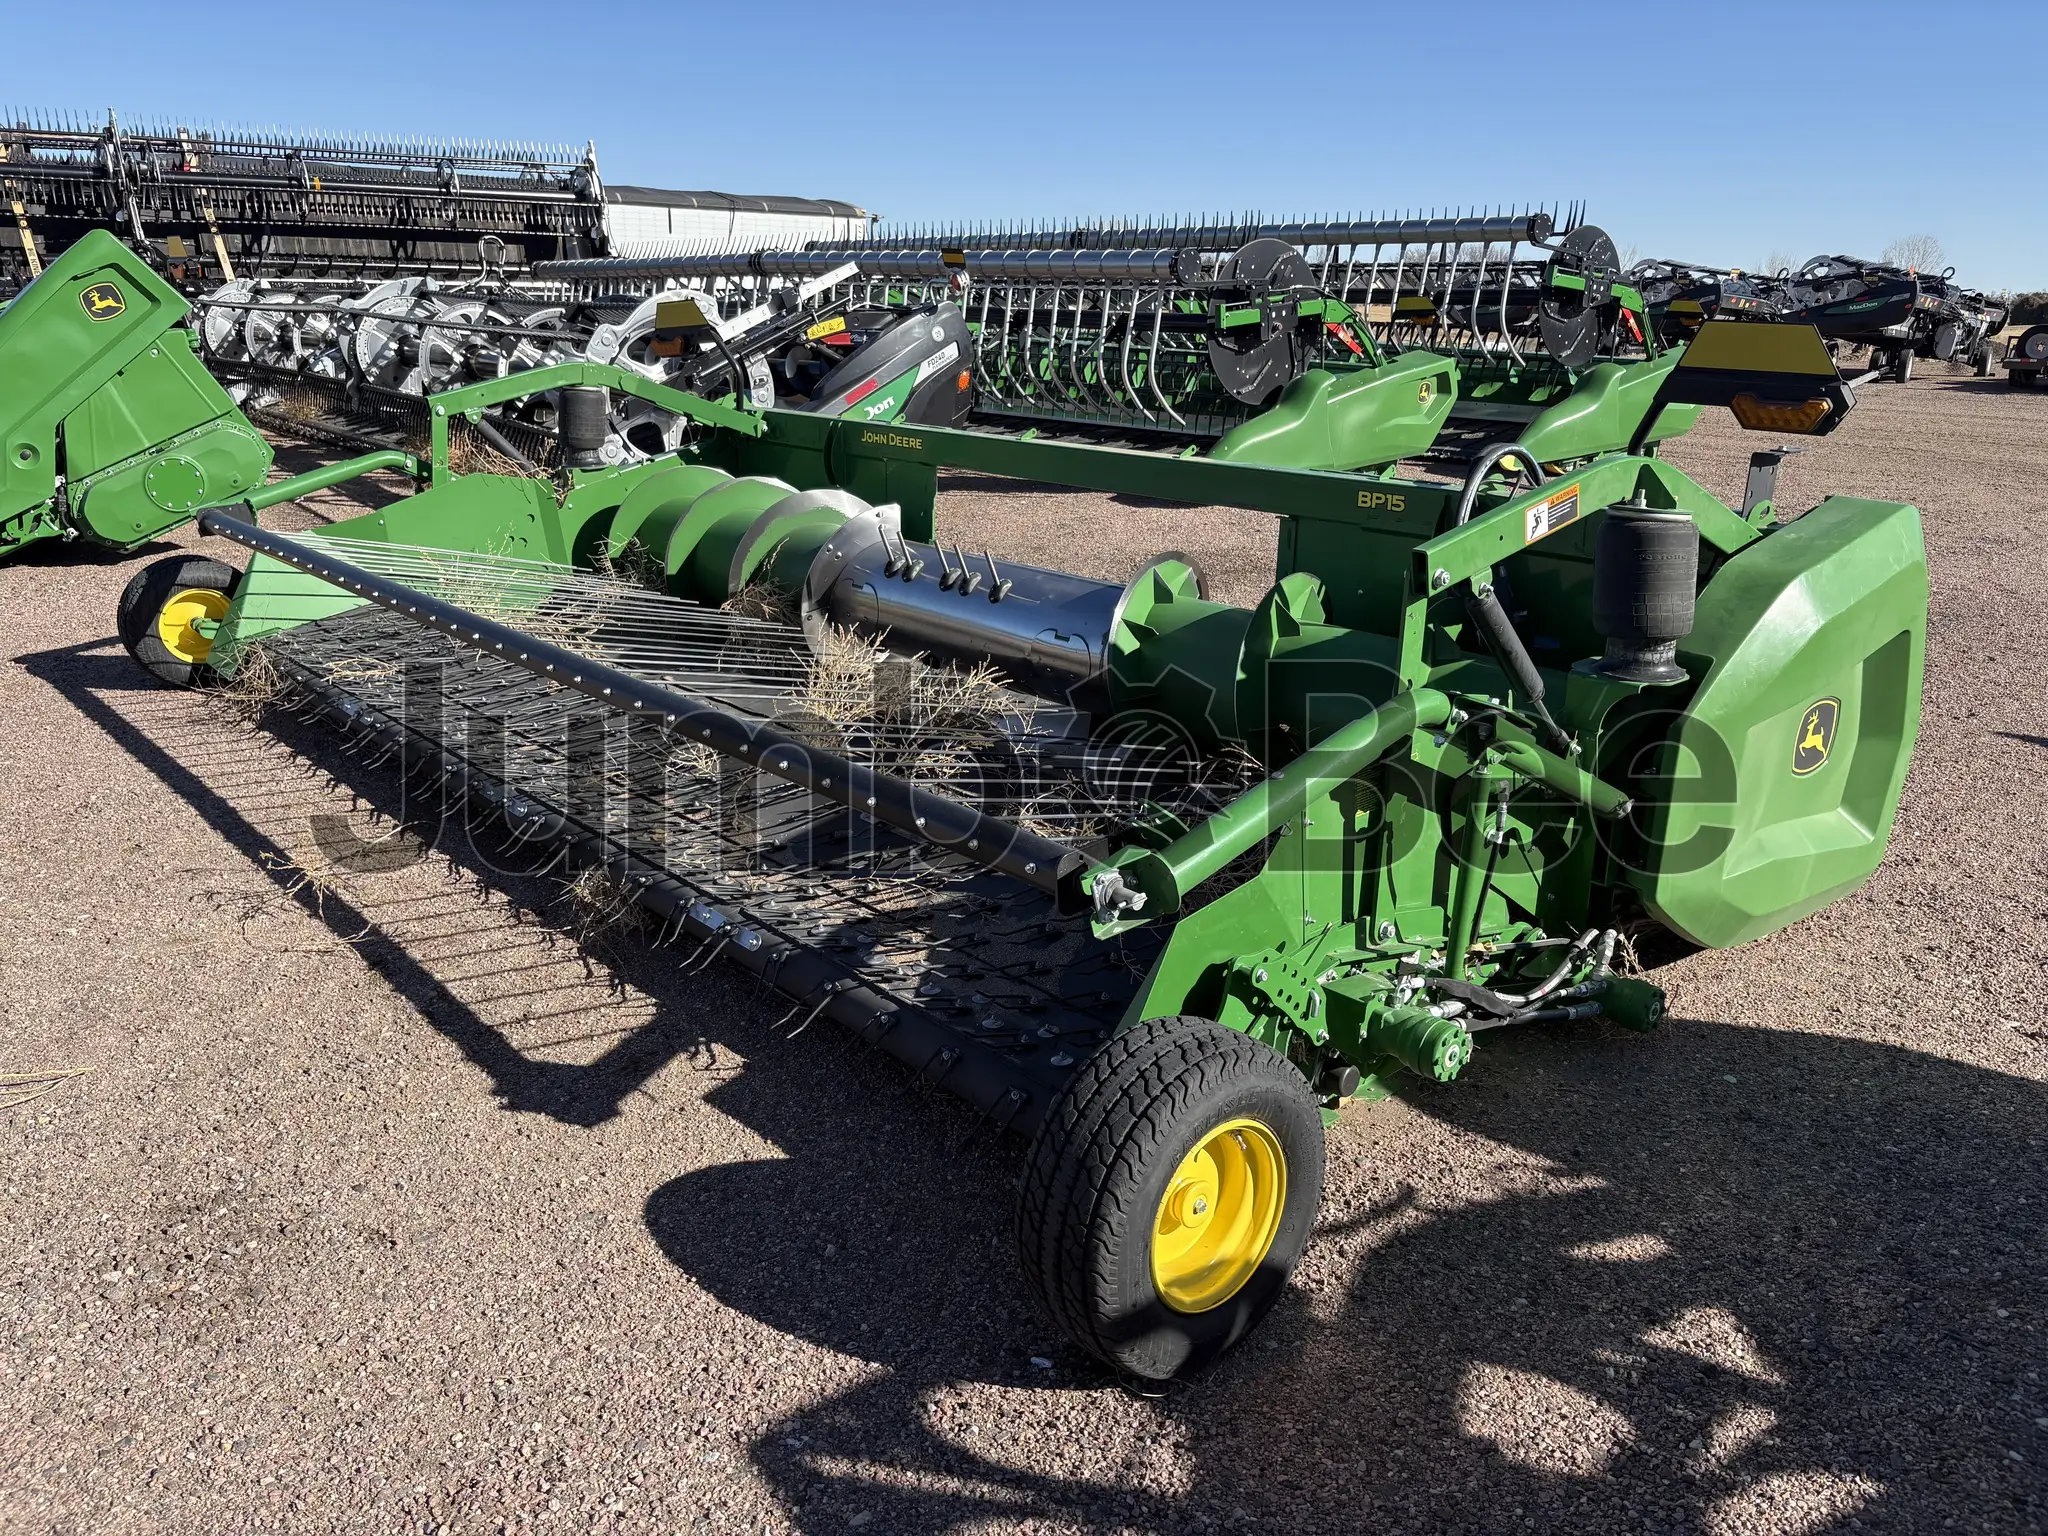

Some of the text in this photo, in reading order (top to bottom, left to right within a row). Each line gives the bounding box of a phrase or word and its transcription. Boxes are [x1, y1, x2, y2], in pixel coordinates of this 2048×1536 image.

[861, 429, 923, 450] JOHN DEERE
[1357, 490, 1406, 512] BP15
